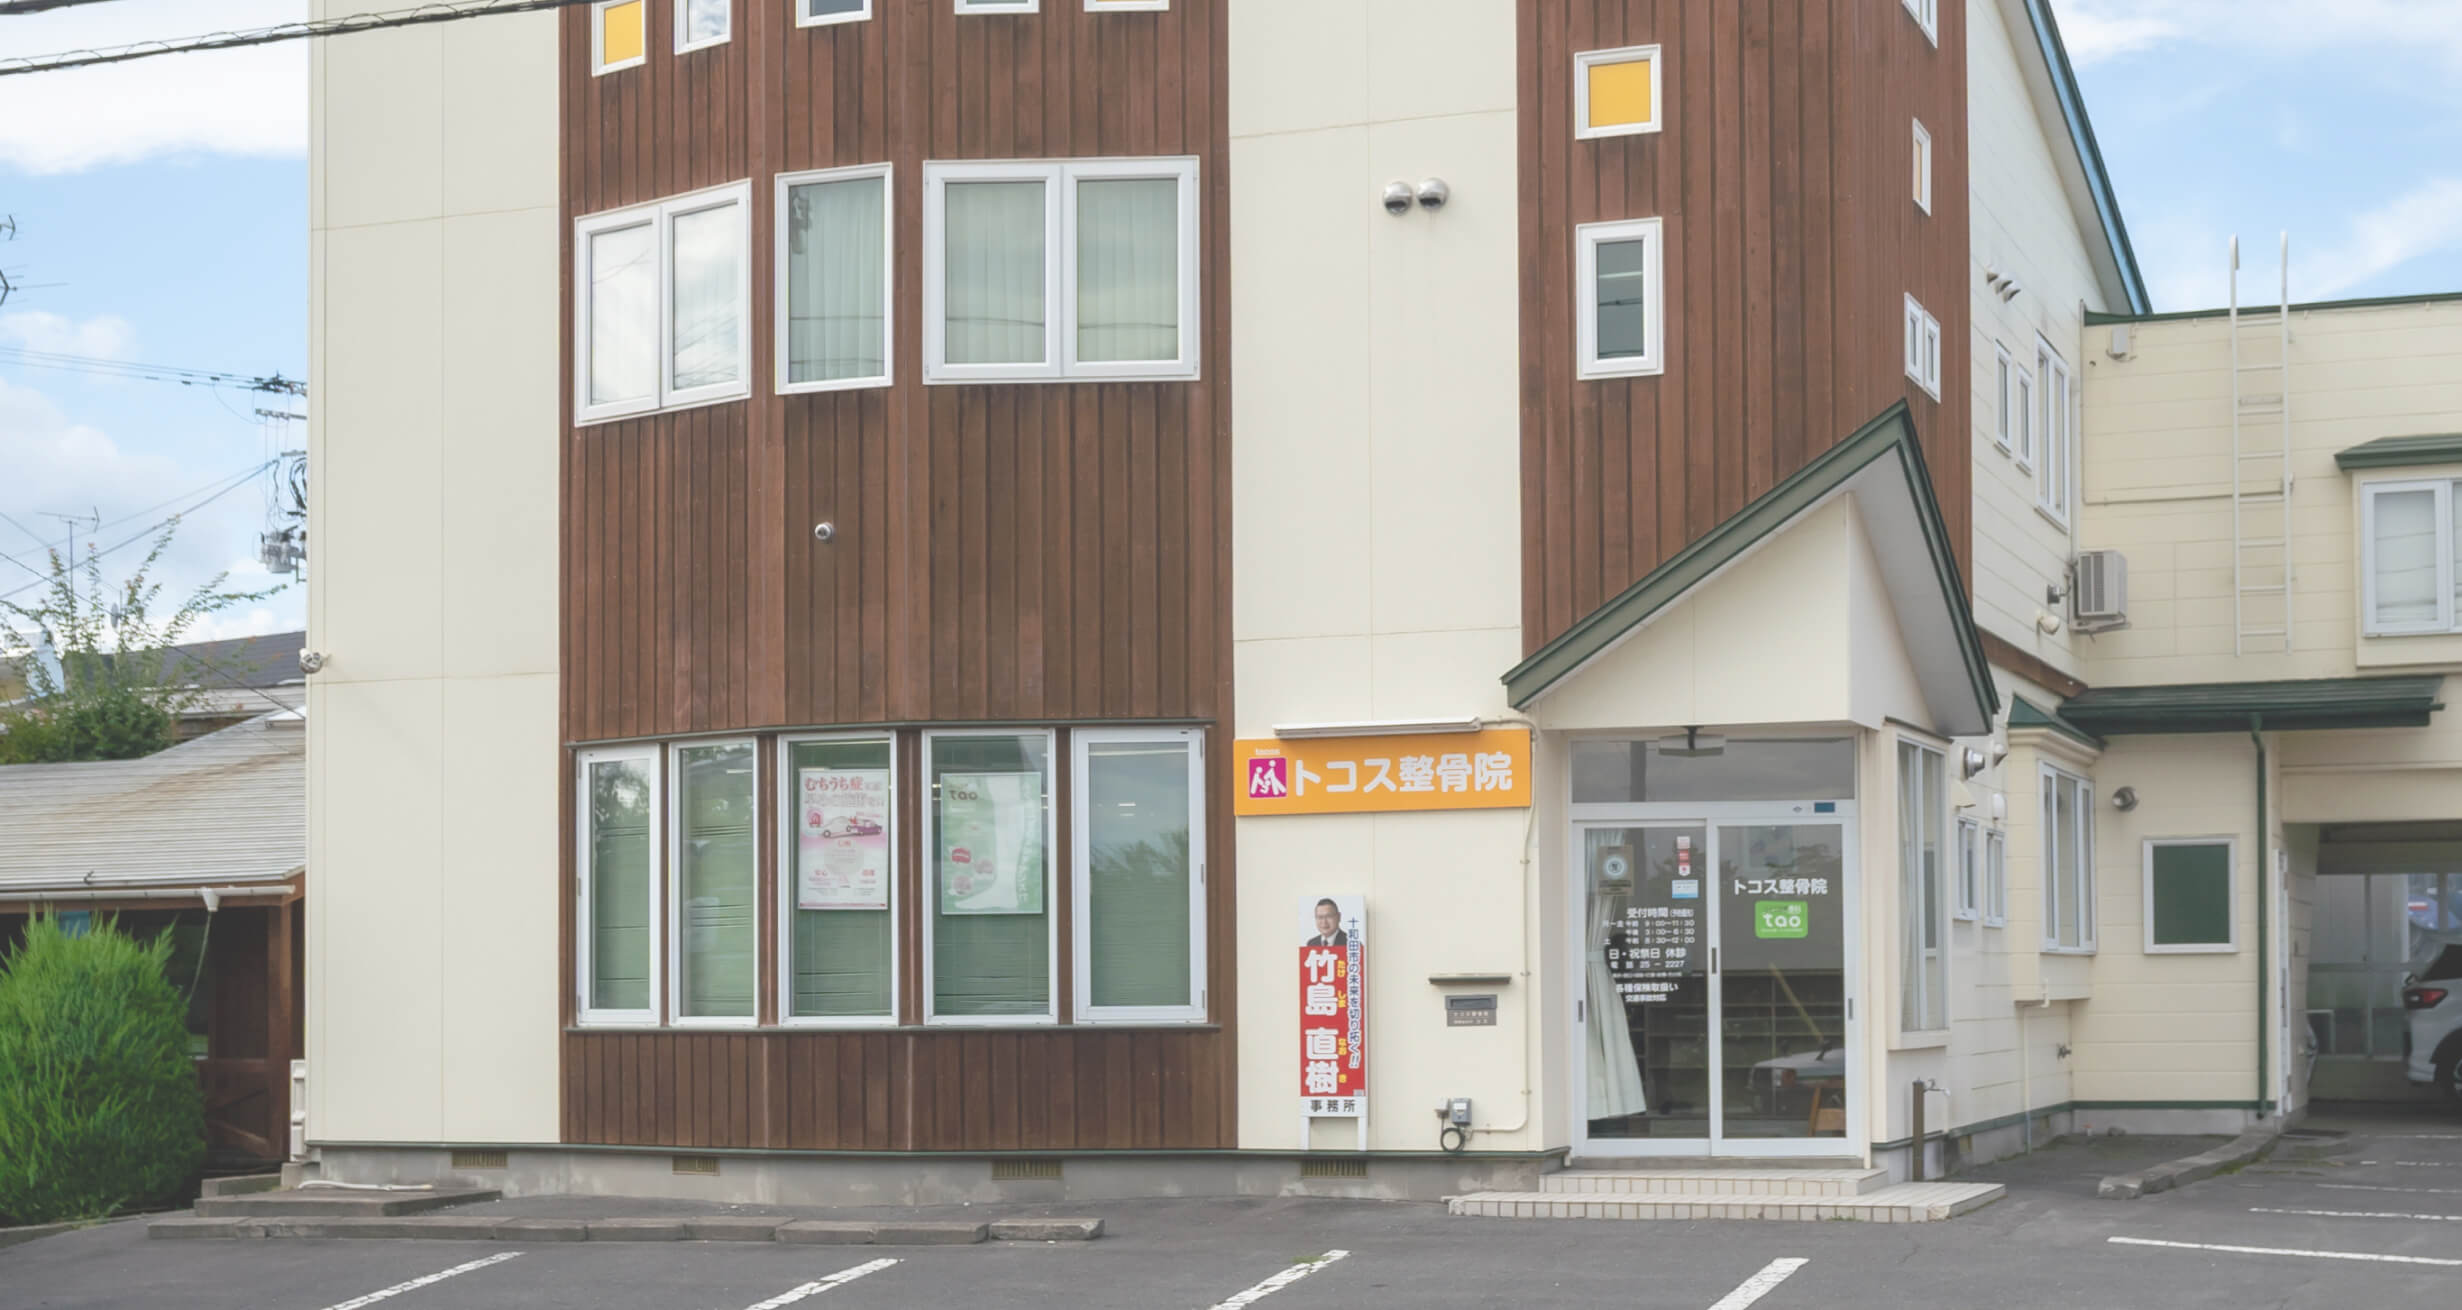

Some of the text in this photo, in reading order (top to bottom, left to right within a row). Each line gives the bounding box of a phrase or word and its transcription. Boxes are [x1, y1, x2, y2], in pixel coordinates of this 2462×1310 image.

[1295, 752, 1513, 797] トコス整骨院
[1734, 878, 1828, 895] トコス整骨院
[1627, 907, 1669, 919] 受付時間
[1763, 913, 1801, 927] tao
[1304, 949, 1339, 1094] 竹島 直樹
[1311, 1099, 1355, 1112] 事務所
